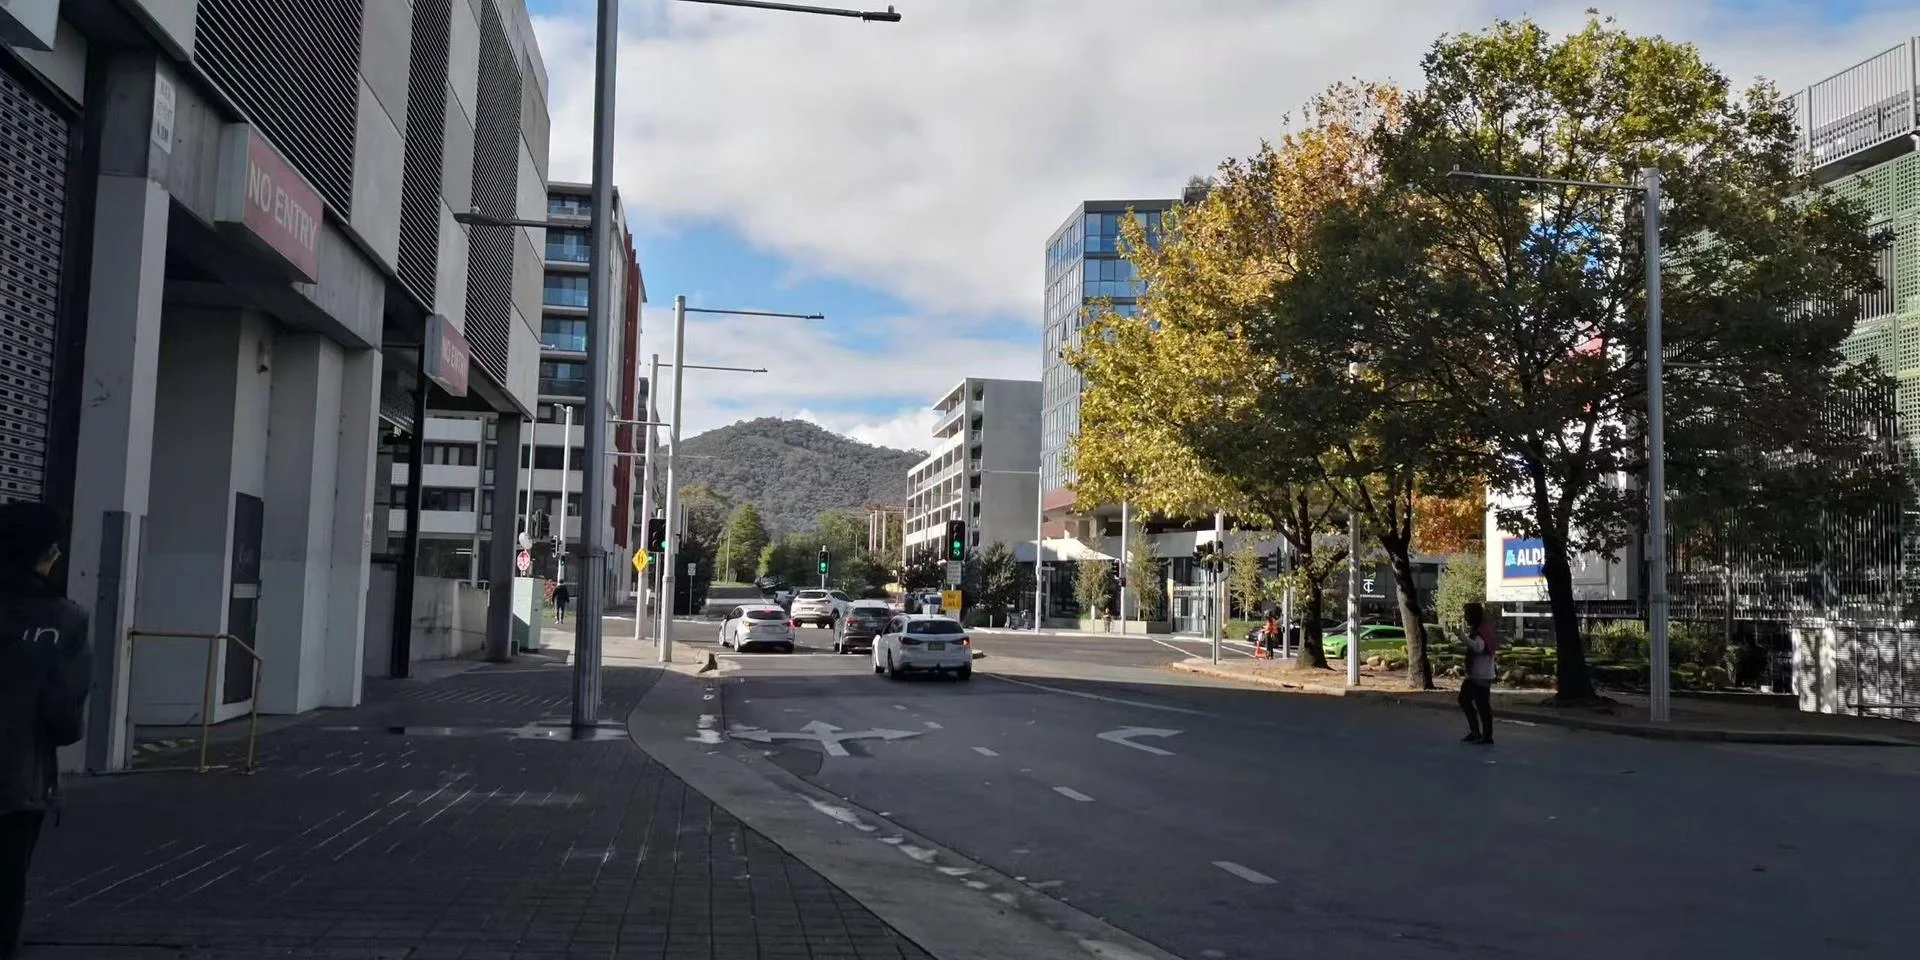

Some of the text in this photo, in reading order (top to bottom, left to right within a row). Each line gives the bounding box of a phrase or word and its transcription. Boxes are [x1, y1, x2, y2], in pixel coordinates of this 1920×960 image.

[249, 161, 318, 251] NO ENTRY
[442, 335, 452, 364] NO
[1517, 547, 1545, 566] ALDI
